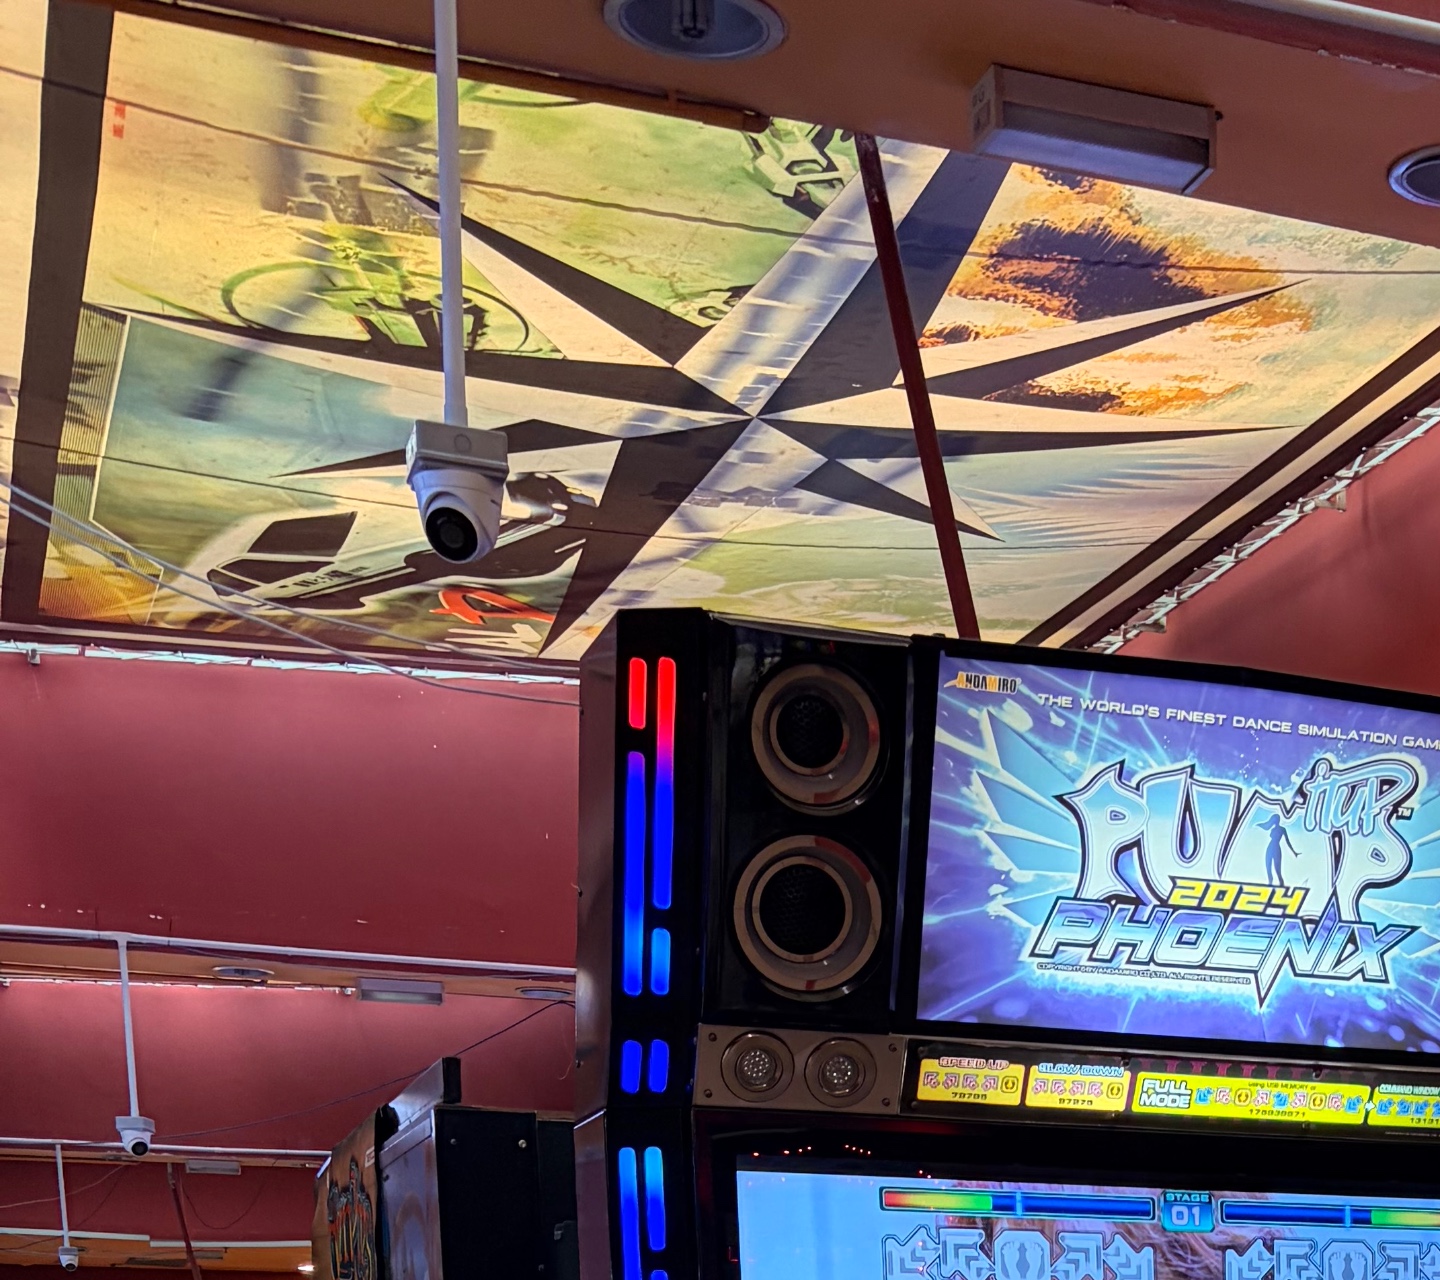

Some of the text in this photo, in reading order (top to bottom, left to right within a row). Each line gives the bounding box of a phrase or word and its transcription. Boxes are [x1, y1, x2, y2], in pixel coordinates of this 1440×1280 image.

[953, 671, 1019, 695] ANDAMIRO
[1037, 693, 1073, 709] THE
[1080, 698, 1160, 719] WORLD'S
[1166, 708, 1227, 727] FINEST
[1232, 715, 1292, 733] DANCE
[1298, 723, 1398, 746] SIMULATION
[1053, 758, 1414, 921] PUMP
[1167, 878, 1306, 915] 2024
[1029, 895, 1422, 1010] PHOENIX
[938, 1056, 1010, 1071] SPEED UP
[1038, 1062, 1125, 1078] SLOW DOWN
[1142, 1078, 1193, 1095] FULL
[1139, 1092, 1191, 1109] MODE
[1165, 1192, 1210, 1203] STAGE
[1171, 1204, 1201, 1227] 01
